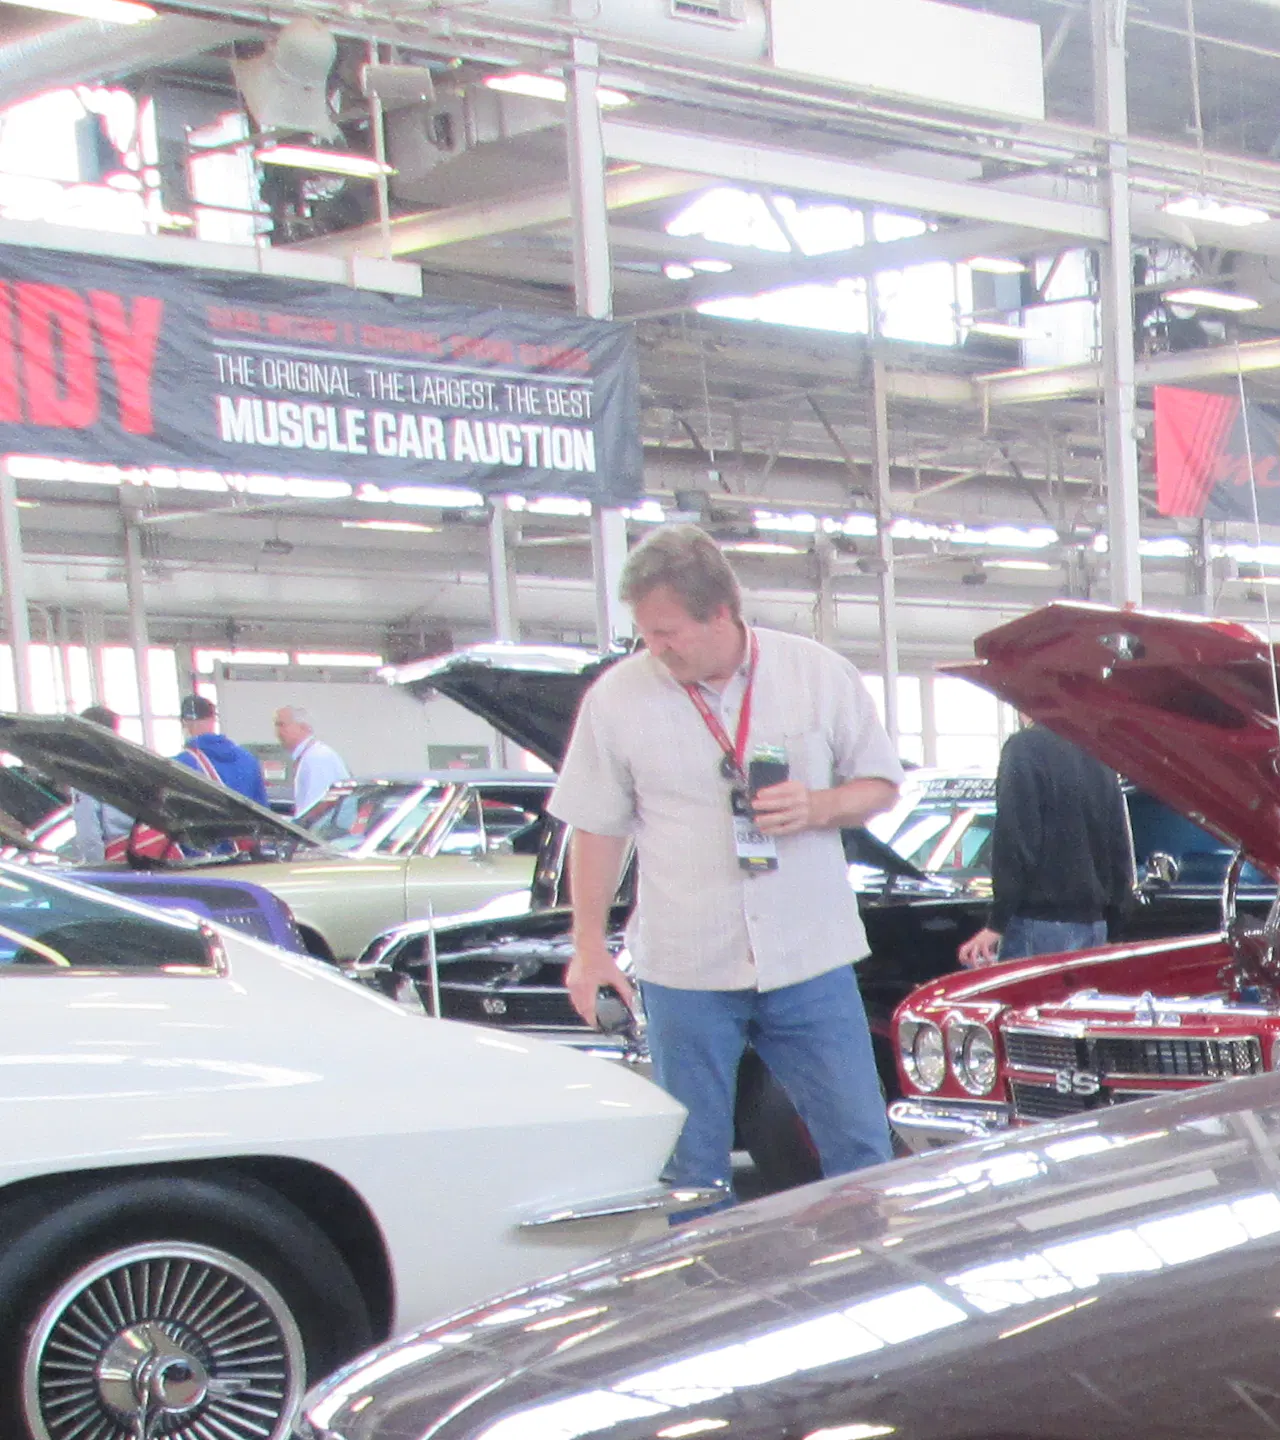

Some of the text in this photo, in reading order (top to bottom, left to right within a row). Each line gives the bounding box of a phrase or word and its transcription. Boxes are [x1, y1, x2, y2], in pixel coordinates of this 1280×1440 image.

[213, 352, 256, 389] THE
[365, 368, 404, 401] THE
[504, 382, 542, 417] THE
[545, 387, 594, 420] BEST
[218, 395, 598, 474] MUSCLE CAR AUCTION
[1055, 1069, 1101, 1096] SS
